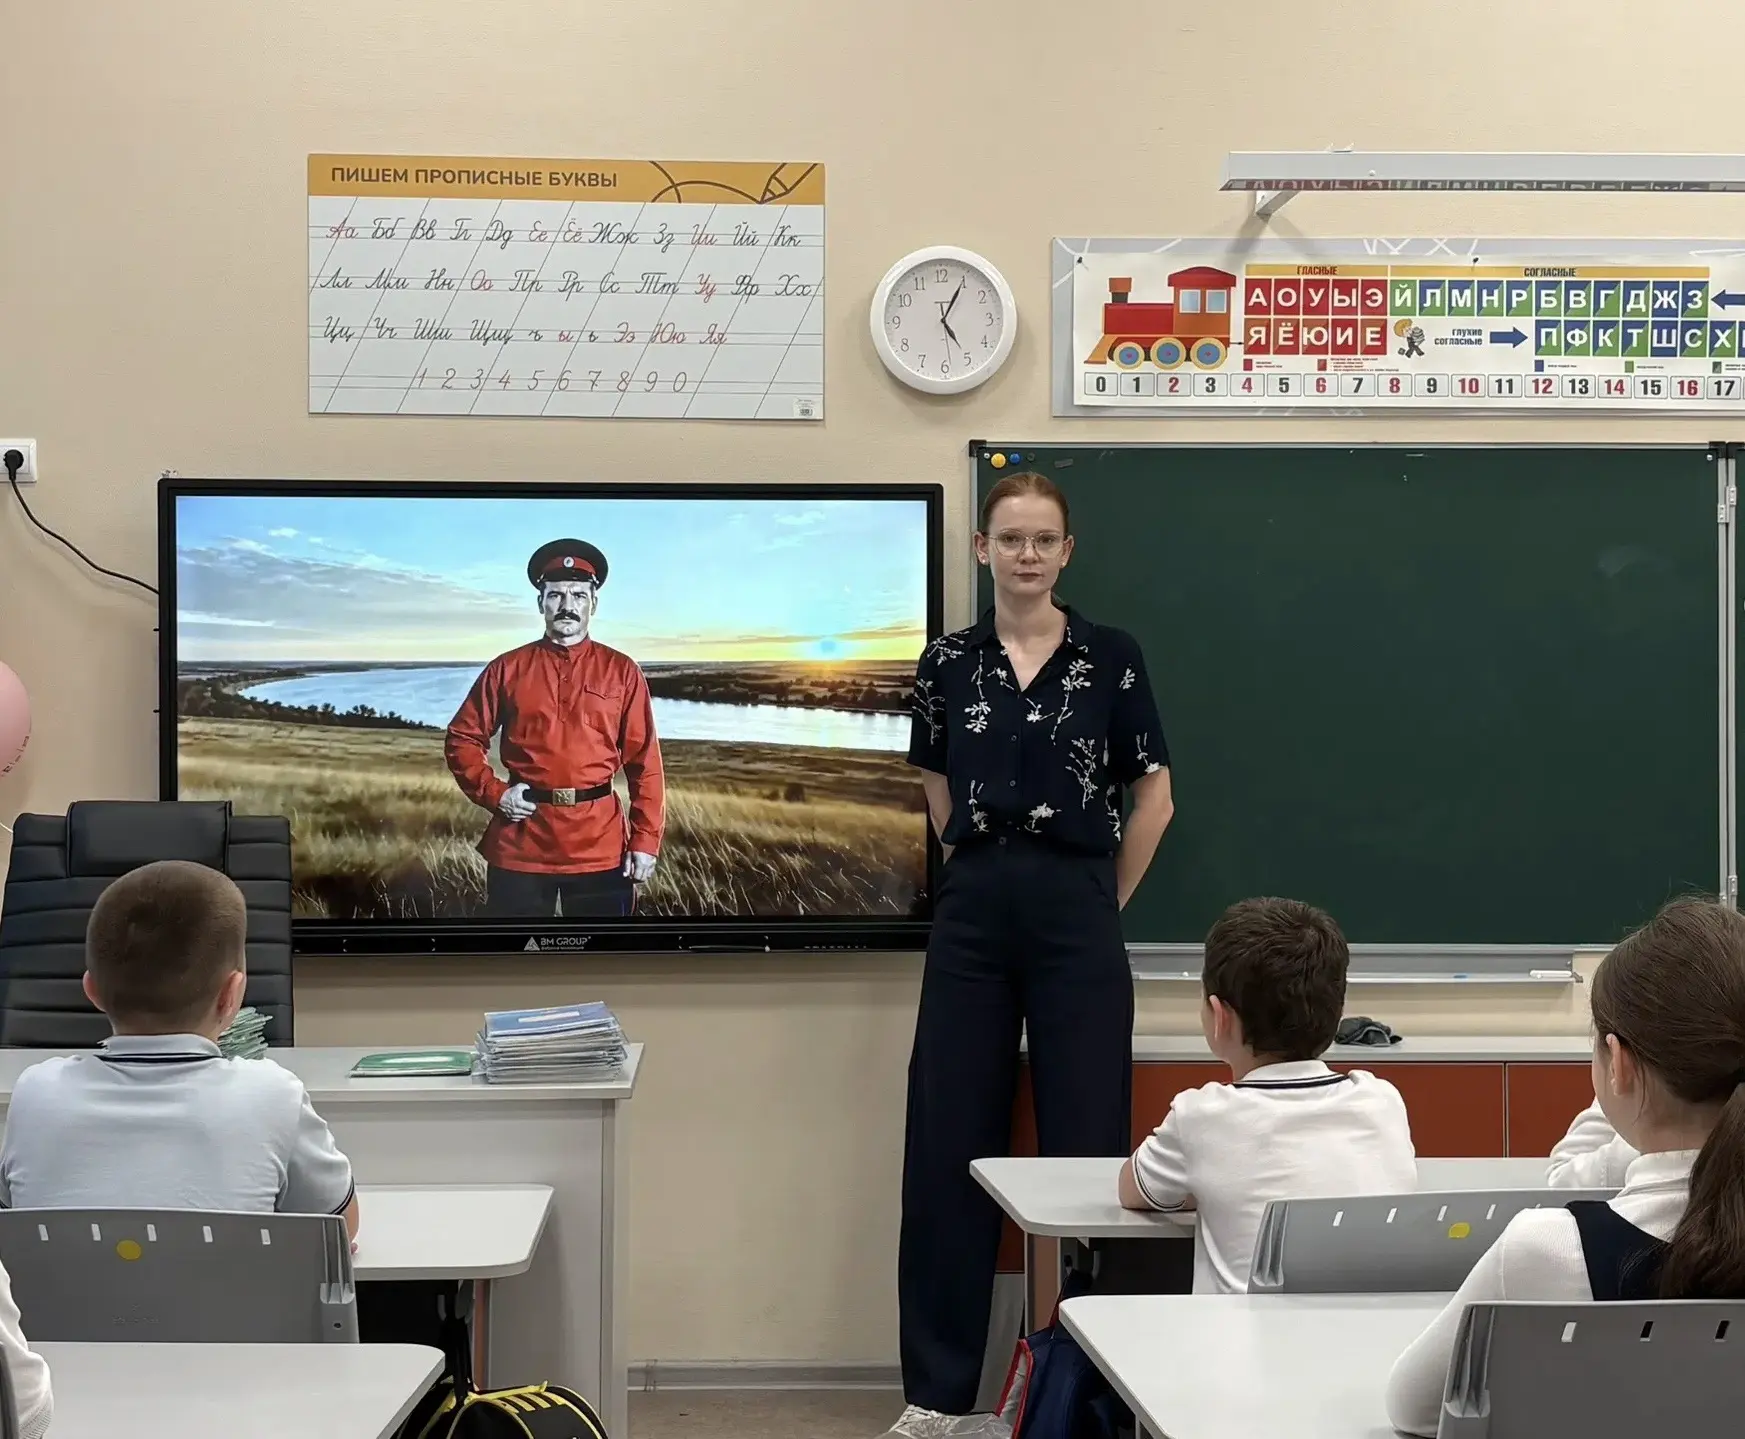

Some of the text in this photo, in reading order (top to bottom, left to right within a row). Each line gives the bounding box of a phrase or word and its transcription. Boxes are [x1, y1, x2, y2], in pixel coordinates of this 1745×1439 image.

[332, 168, 617, 187] ПИШЕМ ПРОПИСНЫЕ БУКВЫ
[326, 217, 801, 253] Аа Бб Вв Гг Дд Ее Ёё Жж Зз Ии Йй Кк
[935, 269, 948, 283] 12
[1297, 266, 1337, 276] ГЛАСНЫЕ
[1524, 268, 1576, 277] СОГЛАСНЫЕ
[320, 267, 812, 303] Лл Мм Нн Оо Пп Рр Сс Тт Уу Фф Хх
[914, 277, 925, 291] 11
[899, 293, 912, 307] 10
[978, 290, 986, 304] 2
[1248, 285, 1702, 312] А О У Ы Э Й Л М Н Р Б В Г Д Ж З
[892, 316, 900, 329] 9
[986, 312, 993, 326] 3
[324, 316, 354, 343] Цц
[374, 317, 397, 339] Чч
[414, 318, 452, 340] Шш
[470, 319, 513, 346] Щщ
[558, 330, 574, 342] ы
[614, 322, 635, 343] Ээ
[650, 322, 686, 344] Юю
[699, 324, 728, 344] Яя
[1248, 323, 1381, 346] Я Ё Ю И Е
[1541, 329, 1557, 346] П
[1566, 328, 1588, 347] Ф
[1599, 329, 1613, 347] К
[1627, 329, 1643, 347] Т
[1652, 329, 1677, 347] Ш
[1684, 329, 1702, 348] С
[1716, 330, 1735, 347] Х
[901, 338, 909, 351] 8
[981, 335, 988, 348] 4
[918, 354, 926, 368] 7
[964, 352, 971, 366] 5
[941, 360, 949, 373] 6
[417, 368, 687, 392] 1 2 3 4 5 6 7 8 9 0
[1096, 377, 1735, 395] 0 1 2 3 4 5 6 7 8 9 10 11 12 13 14 15 16 17
